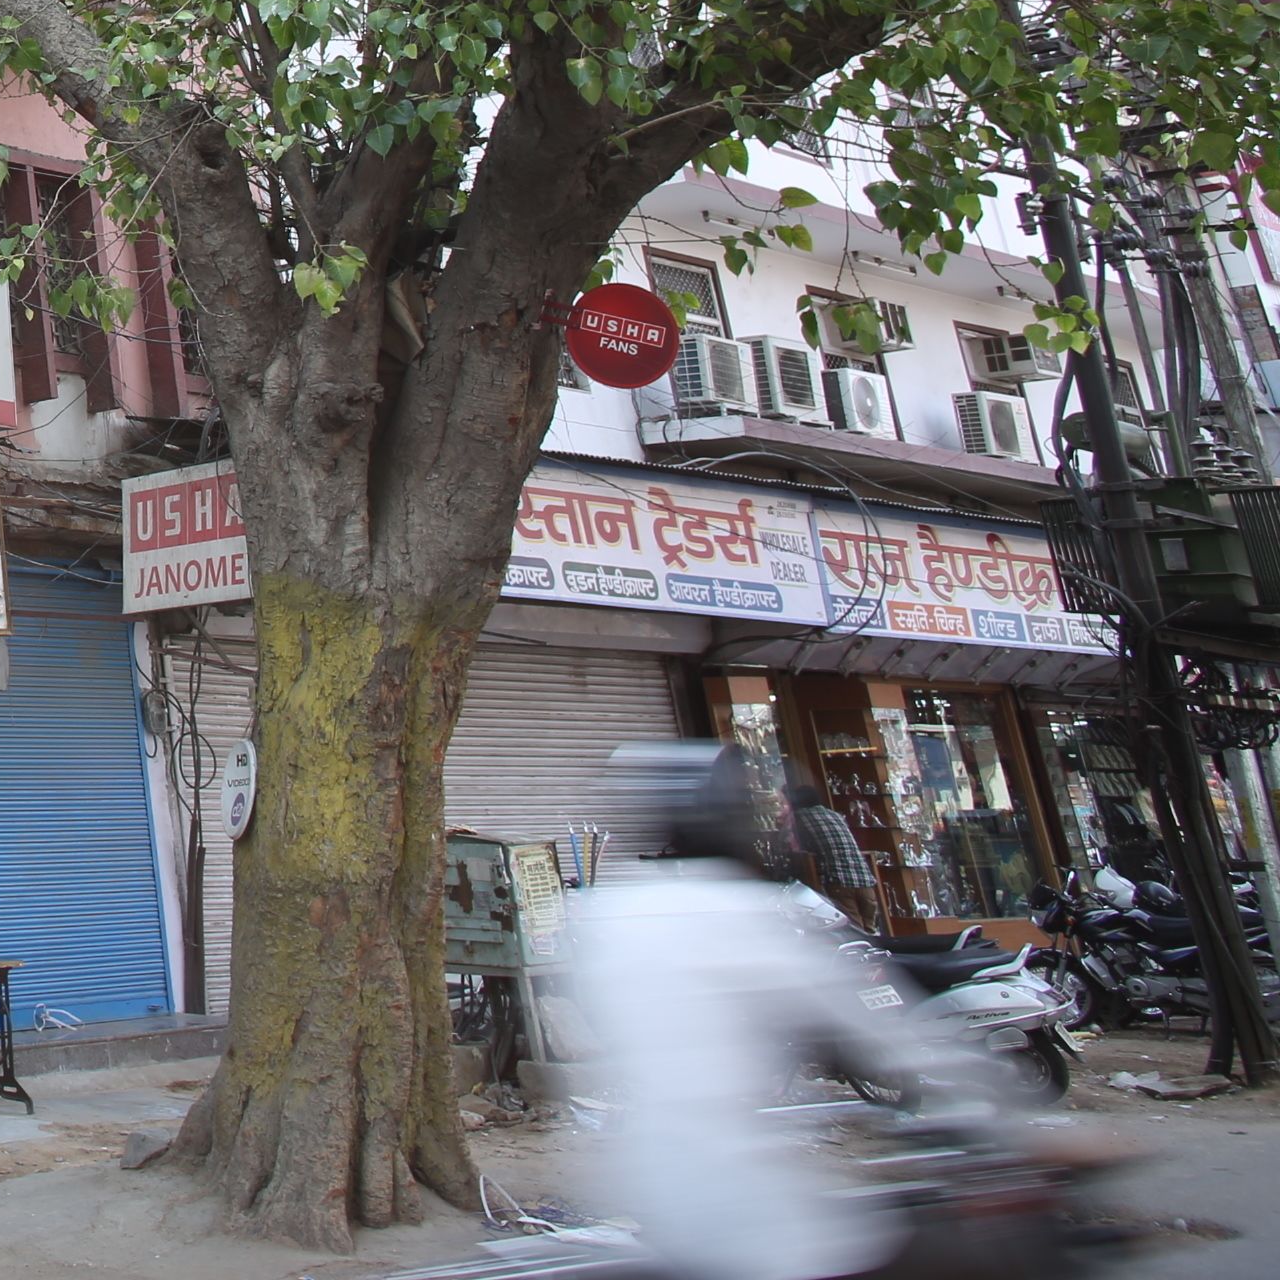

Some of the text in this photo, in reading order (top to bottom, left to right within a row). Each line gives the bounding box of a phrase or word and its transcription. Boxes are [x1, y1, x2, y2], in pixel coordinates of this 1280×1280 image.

[587, 315, 659, 342] USHA
[600, 337, 638, 355] FANS
[137, 484, 244, 541] USHA
[134, 554, 245, 598] JANOME
[771, 562, 807, 584] DEALER
